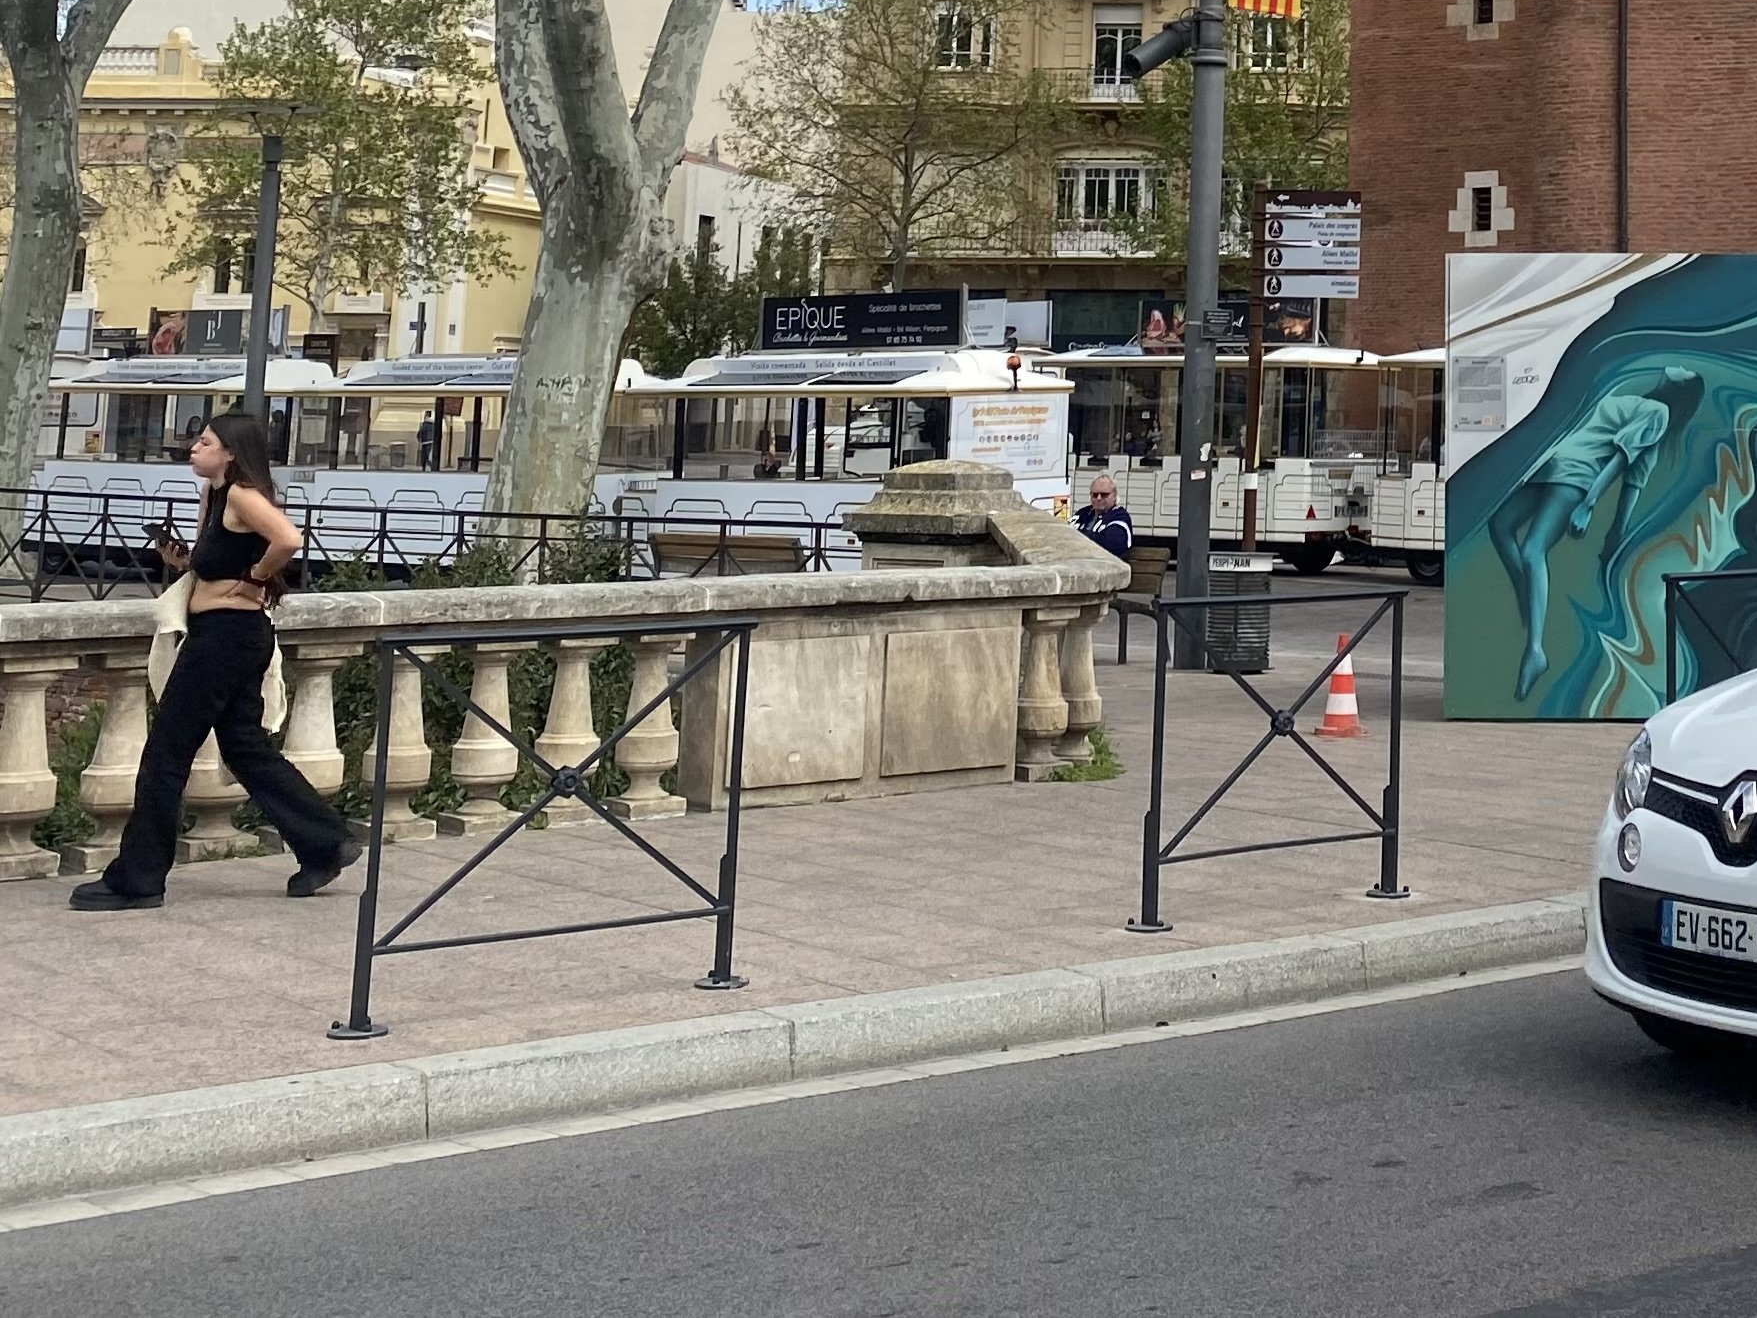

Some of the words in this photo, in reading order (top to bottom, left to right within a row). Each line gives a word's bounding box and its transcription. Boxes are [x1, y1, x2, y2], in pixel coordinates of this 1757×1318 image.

[776, 302, 847, 331] EPIQUE
[391, 363, 411, 371] Guided
[425, 362, 432, 370] of
[432, 362, 442, 370] the
[815, 360, 836, 369] Salida
